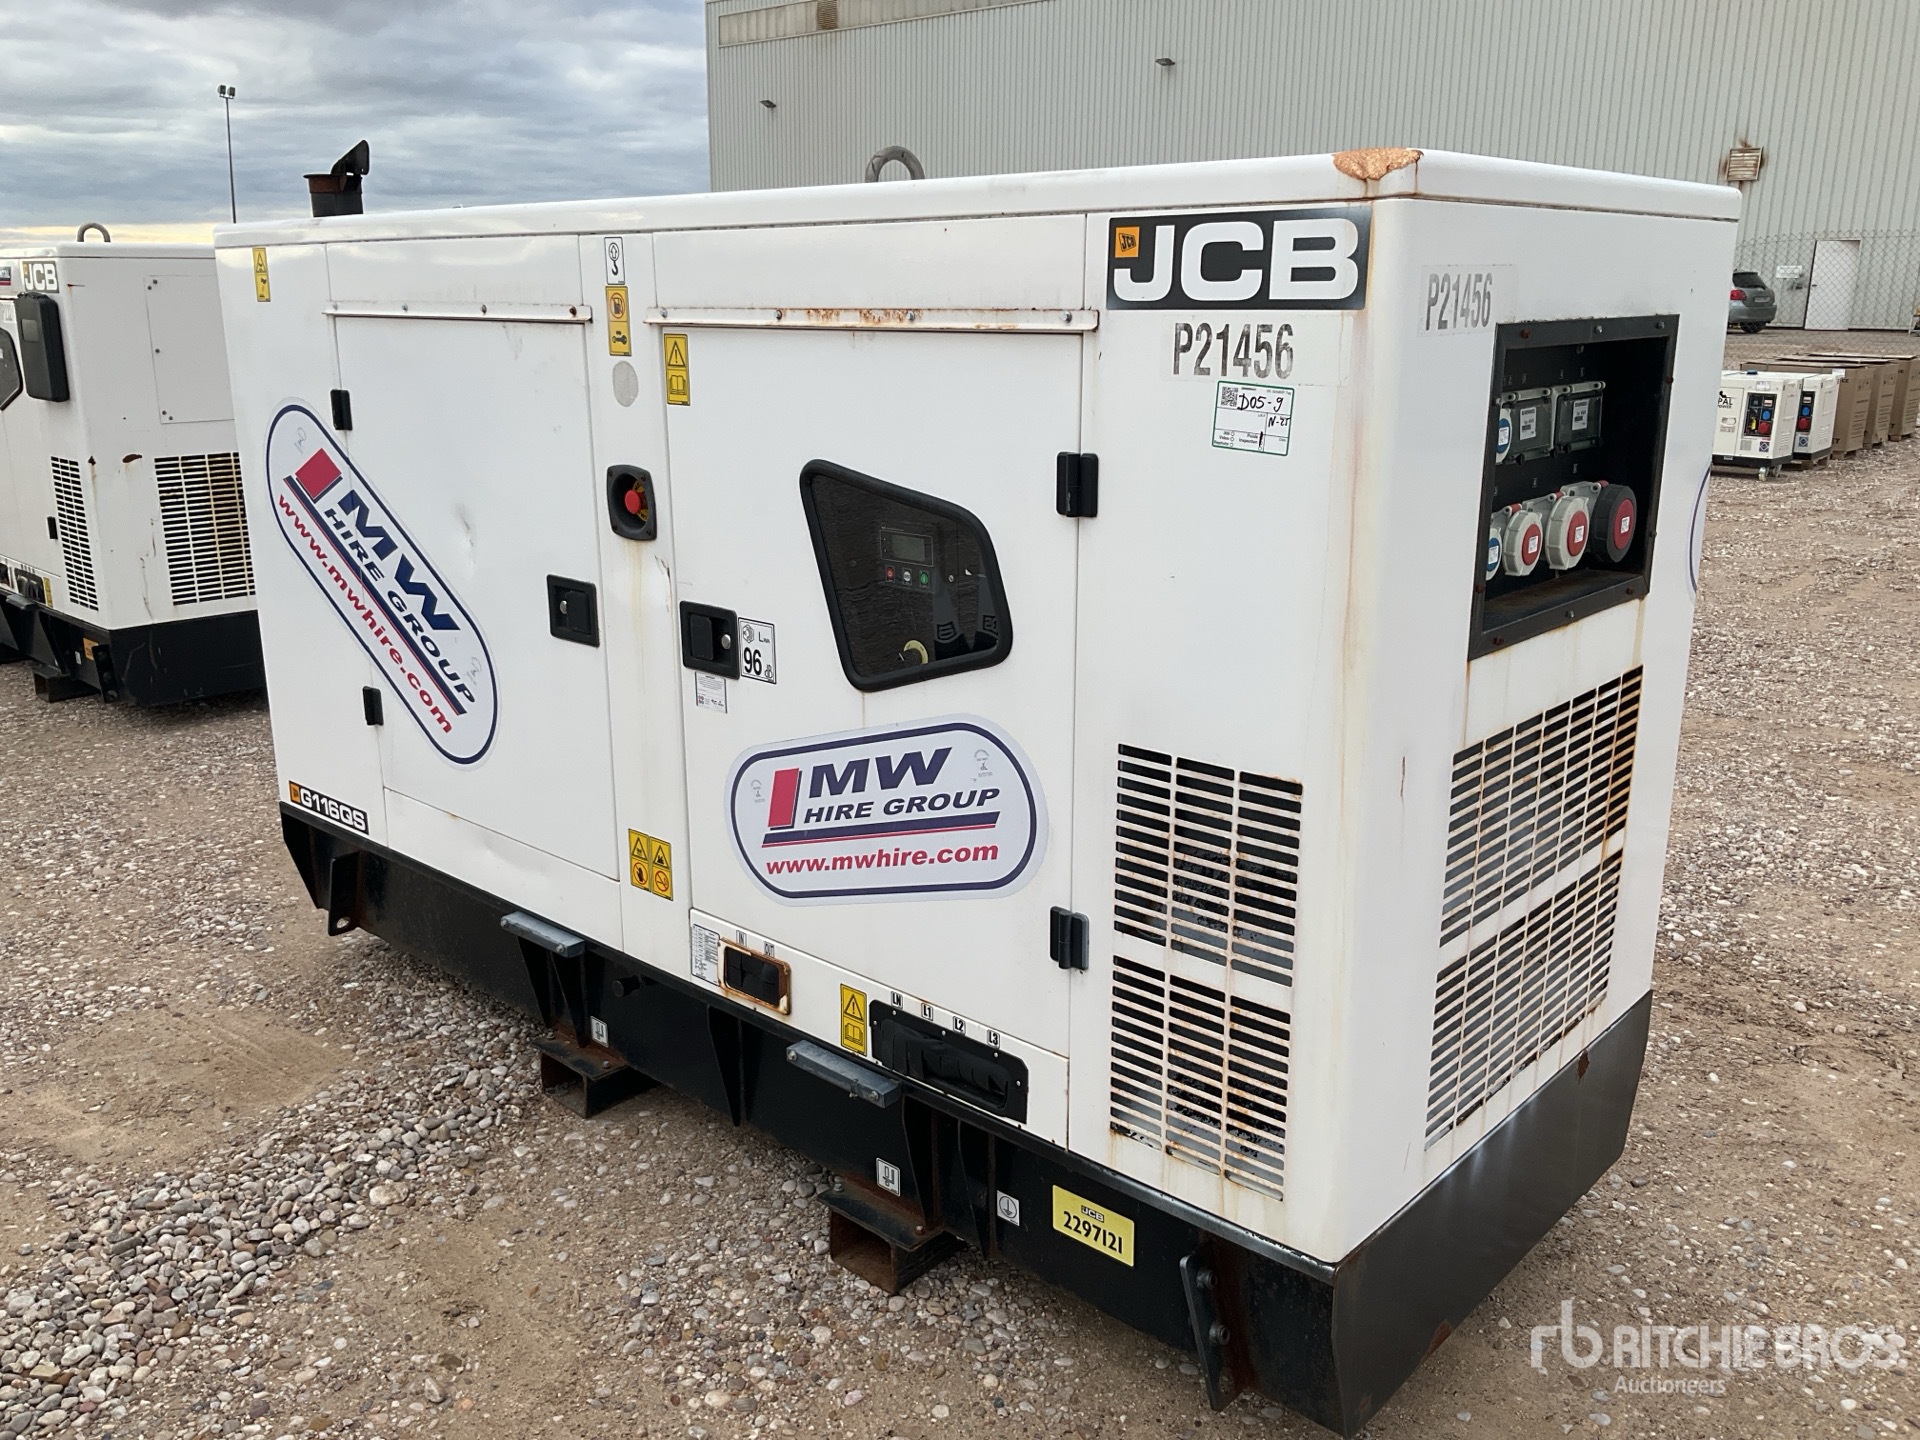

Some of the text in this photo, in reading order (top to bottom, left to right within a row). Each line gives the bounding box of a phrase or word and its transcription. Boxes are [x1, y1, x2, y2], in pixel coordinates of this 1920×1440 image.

[25, 263, 58, 291] JCB
[1113, 217, 1359, 302] JCB
[1425, 273, 1494, 331] P21456
[1172, 322, 1294, 379] P21456
[337, 489, 460, 631] MW
[279, 493, 452, 734] www.mwhire.com
[324, 508, 476, 703] HIRE GROUP
[744, 647, 763, 676] 96
[808, 746, 953, 799] MW
[300, 787, 366, 831] G116QS
[804, 788, 1000, 824] HIRE GROUP
[766, 844, 998, 875] www.mwhire.com
[923, 1004, 931, 1019] L1
[954, 1018, 964, 1032] L2
[989, 1031, 998, 1046] L3
[1063, 1210, 1122, 1254] 2297121
[1082, 1206, 1104, 1222] JCB
